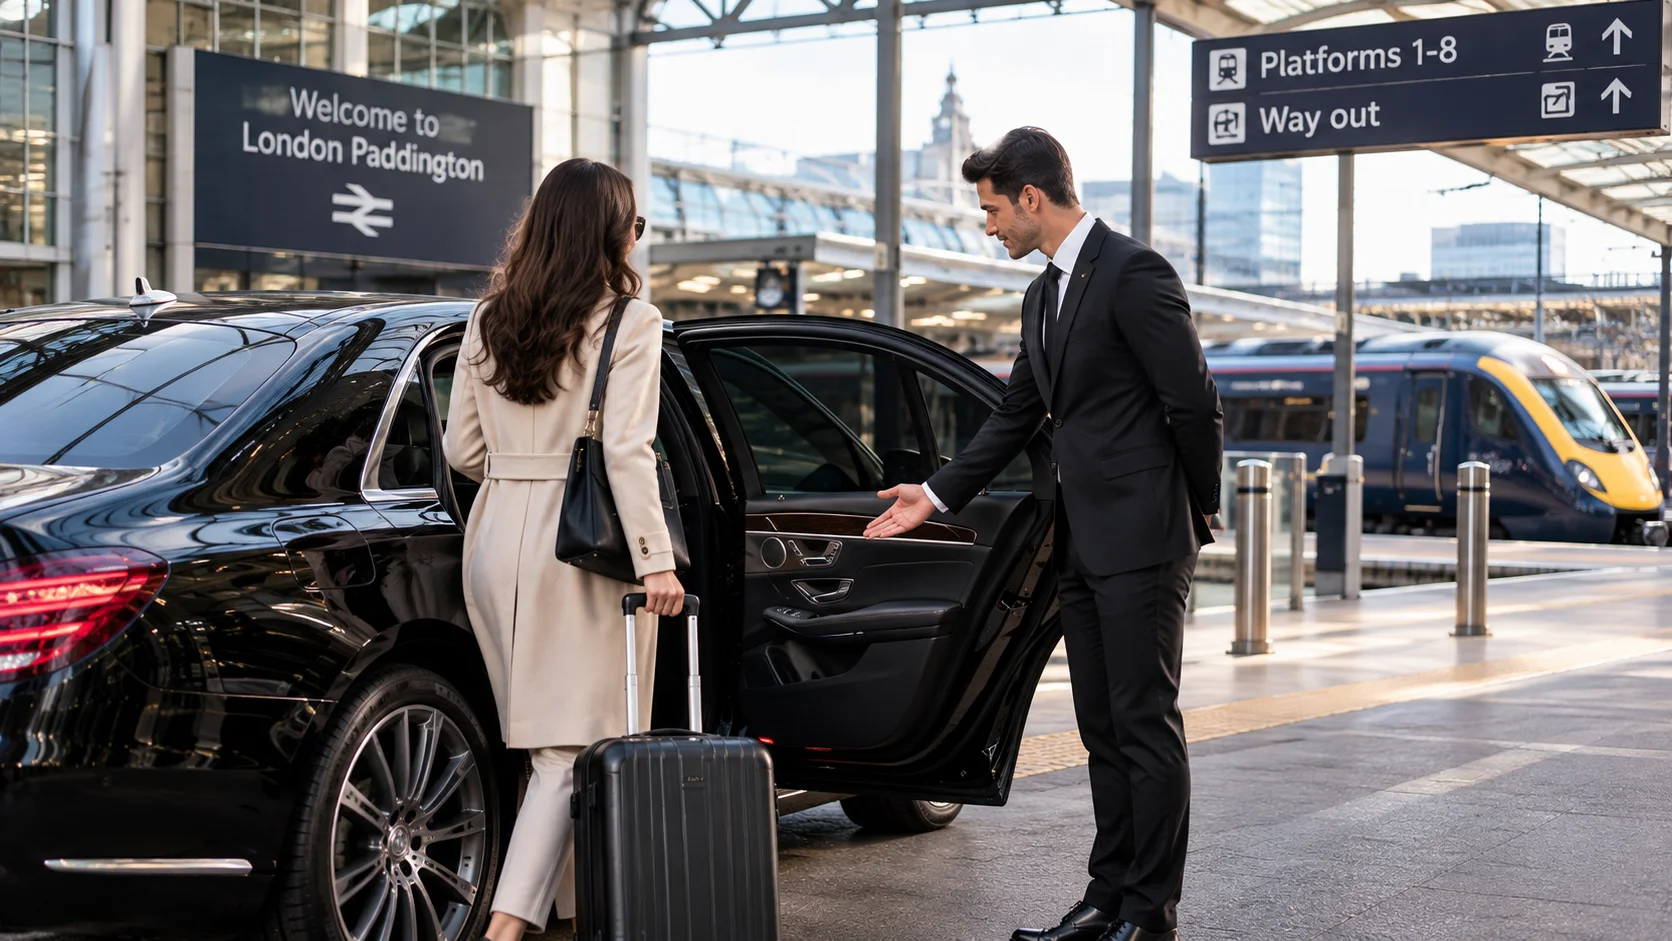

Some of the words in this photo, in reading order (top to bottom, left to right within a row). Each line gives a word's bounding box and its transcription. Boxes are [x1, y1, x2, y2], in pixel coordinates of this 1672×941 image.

[1261, 45, 1402, 79] Platforms
[1412, 35, 1458, 66] 1-8
[290, 86, 407, 133] Welcome
[414, 108, 440, 138] to
[1259, 105, 1322, 138] Way
[1330, 101, 1381, 130] out
[242, 121, 343, 164] London
[351, 135, 485, 184] Paddington
